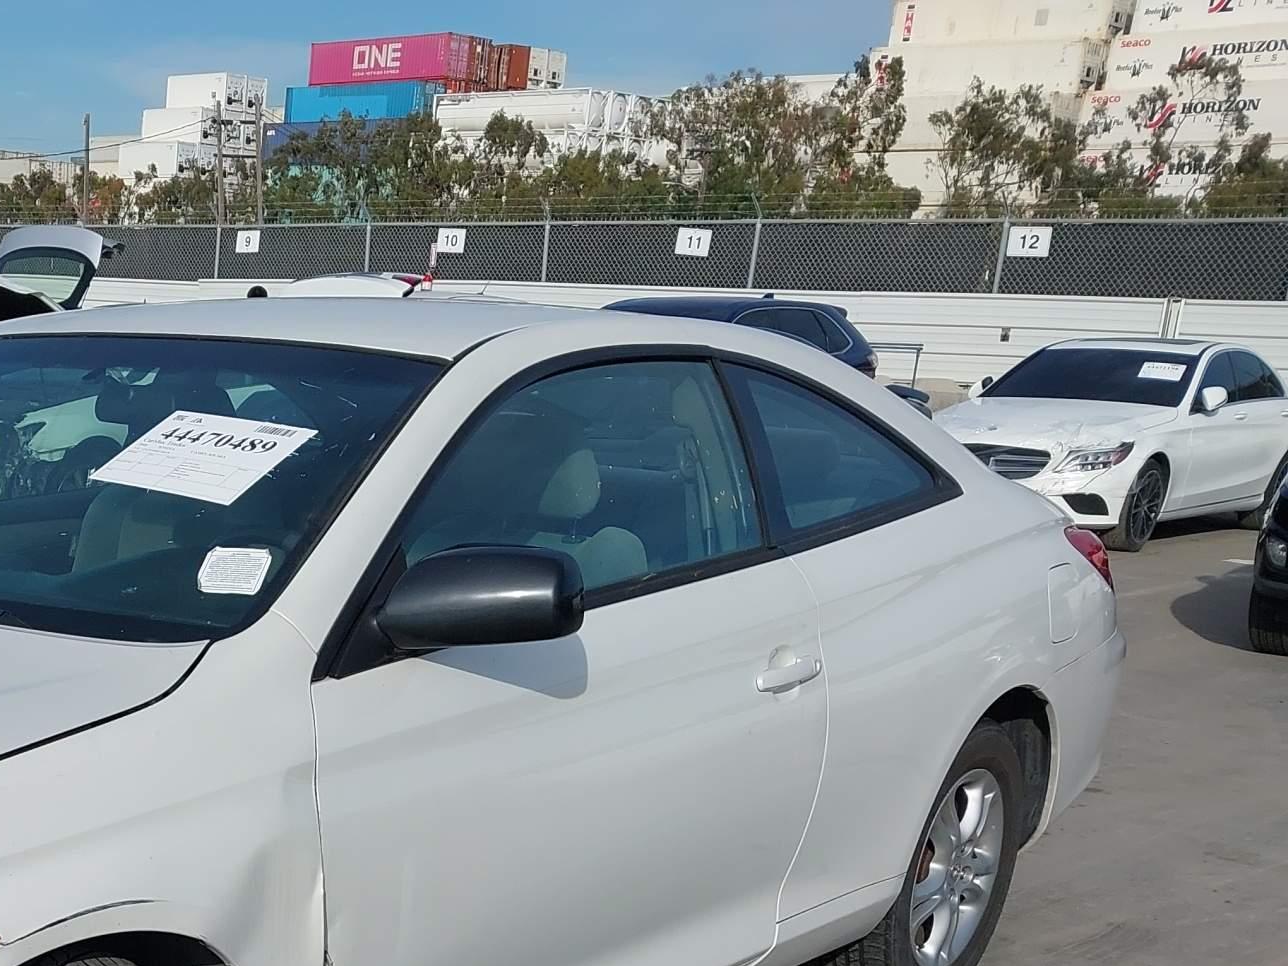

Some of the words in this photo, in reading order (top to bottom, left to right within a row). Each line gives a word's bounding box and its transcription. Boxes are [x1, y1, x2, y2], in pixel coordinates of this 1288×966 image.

[1121, 38, 1151, 48] seaco
[352, 43, 402, 70] ONE
[1091, 94, 1121, 104] seaco
[1179, 98, 1262, 115] HORIZON
[244, 236, 251, 248] 9
[444, 234, 458, 247] 10
[687, 235, 703, 250] 11
[1019, 234, 1041, 250] 12
[160, 427, 278, 453] 44470489
